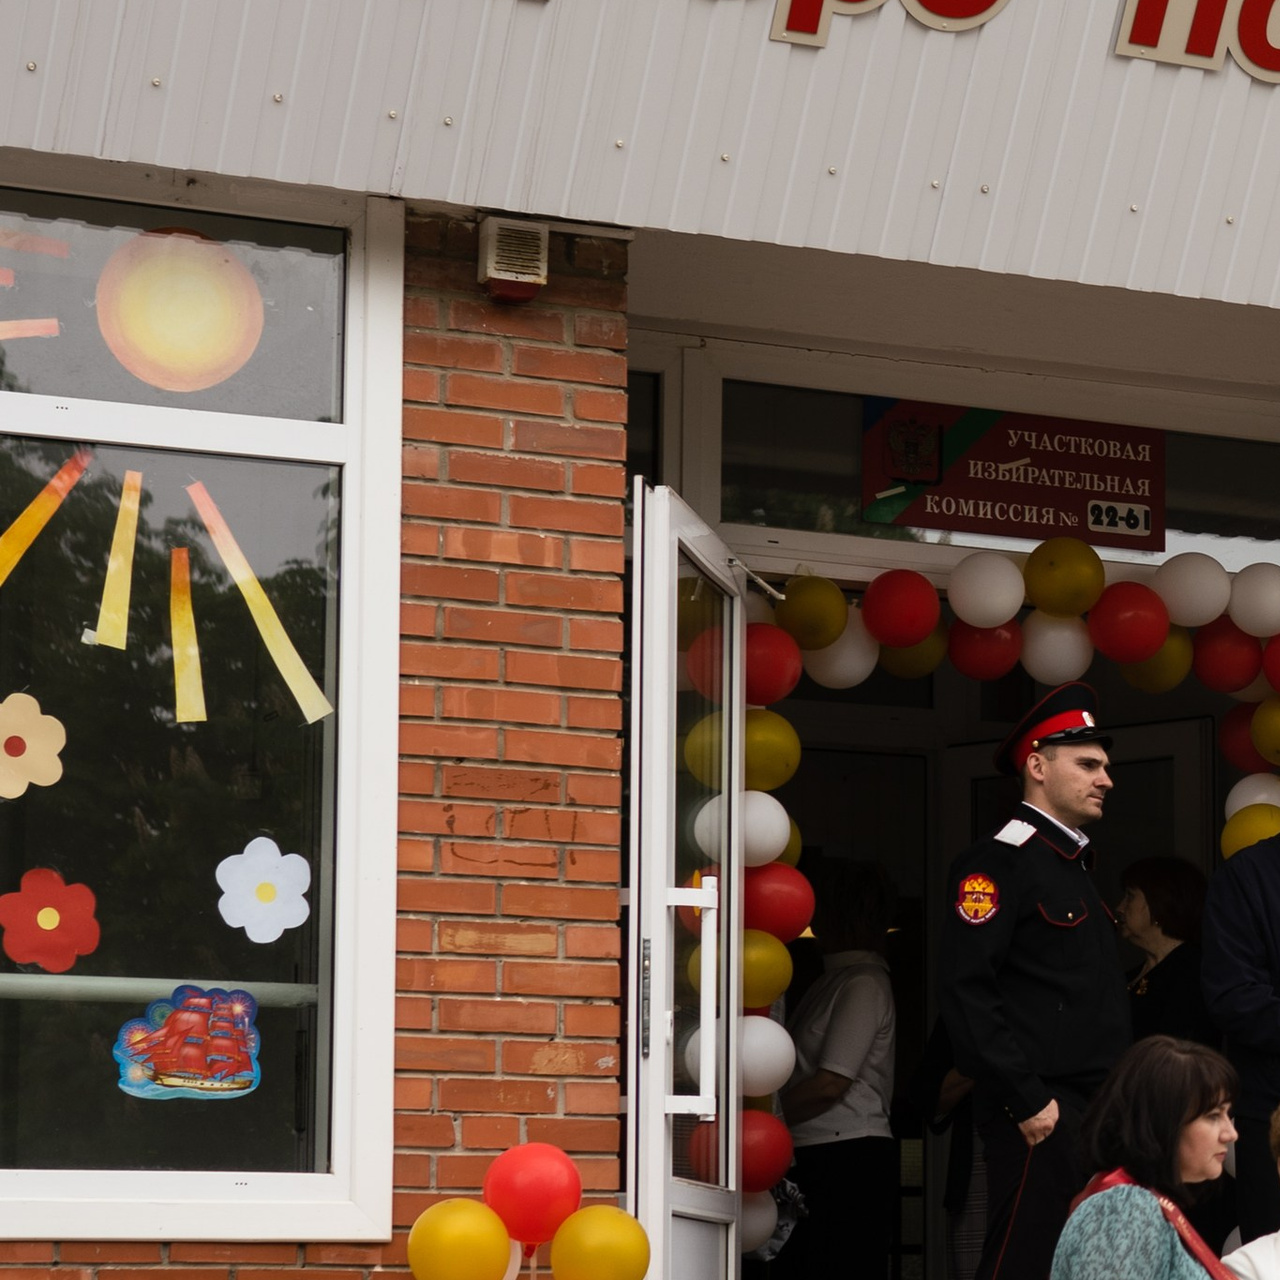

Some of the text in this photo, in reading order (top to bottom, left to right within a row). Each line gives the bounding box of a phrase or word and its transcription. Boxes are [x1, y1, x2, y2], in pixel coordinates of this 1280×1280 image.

[1007, 428, 1151, 463] УЧАСТКОВАЯ
[967, 459, 1151, 497] ИЗБИРАТЕЛЬНАЯ
[924, 494, 1056, 526] КОМИССИЯ
